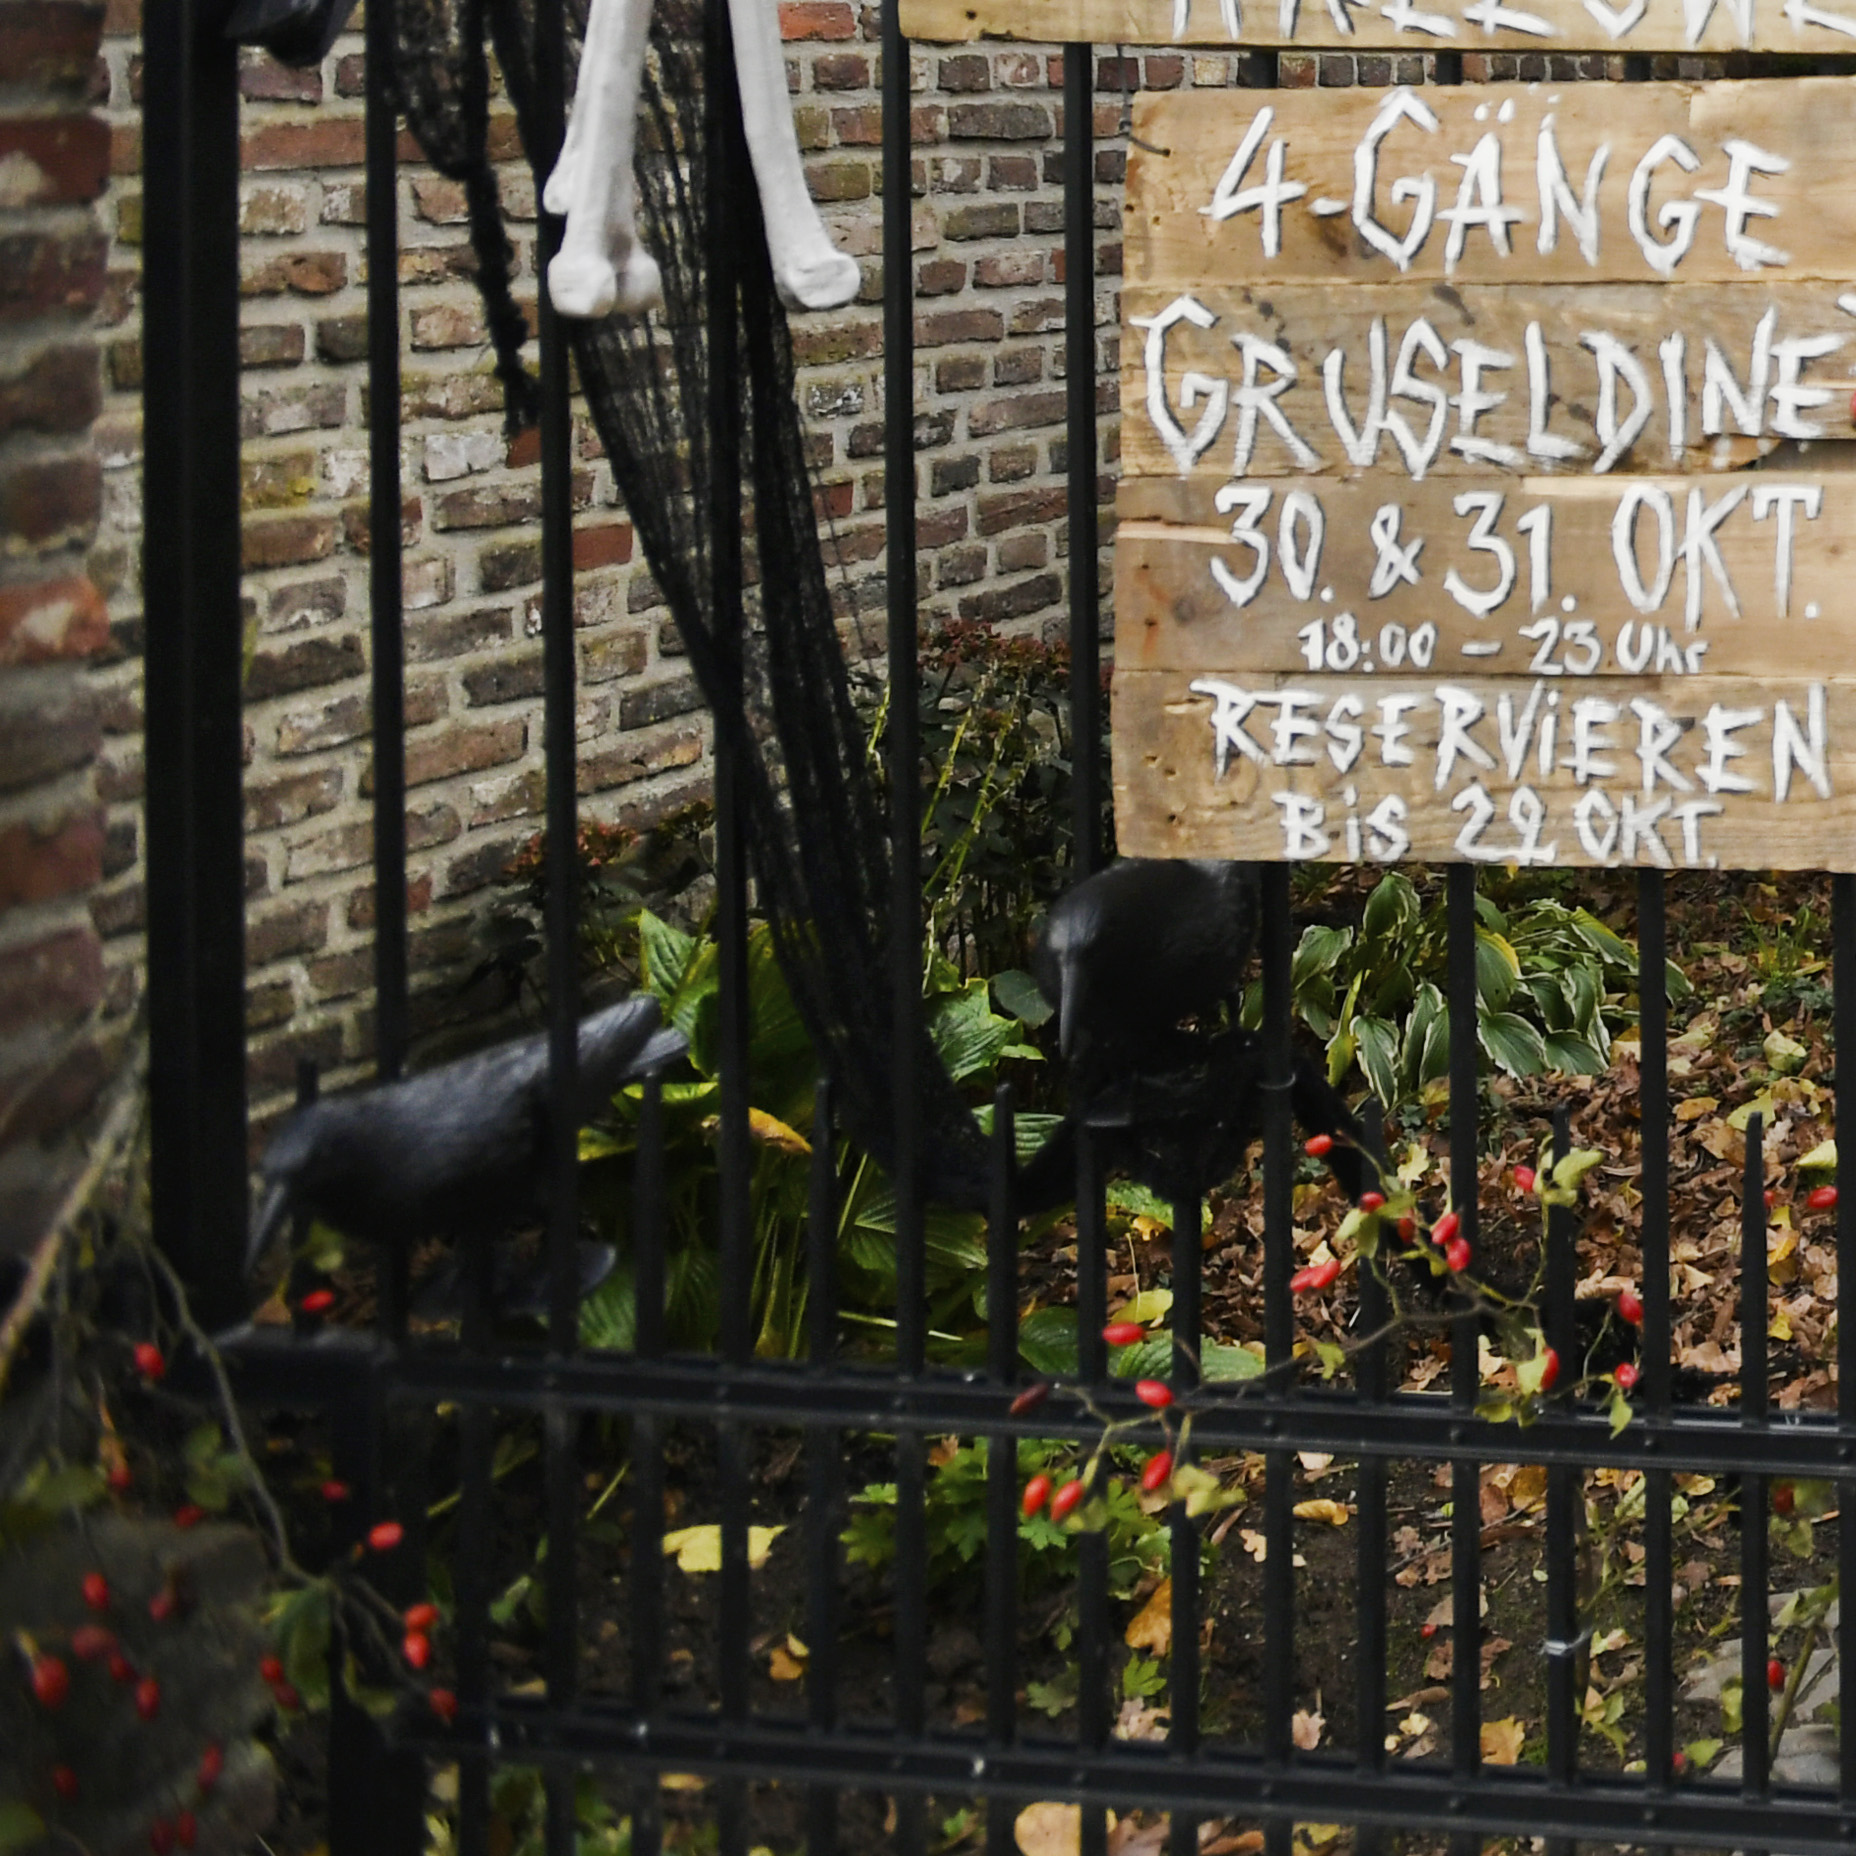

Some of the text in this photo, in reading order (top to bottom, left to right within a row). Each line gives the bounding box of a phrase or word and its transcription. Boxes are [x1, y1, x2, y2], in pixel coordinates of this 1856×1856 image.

[1210, 484, 1824, 632] 30. & 31. OKT.
[1298, 612, 1436, 671] 18:00
[1519, 616, 1600, 674] 23
[1616, 628, 1709, 675] Uhr
[1572, 788, 1724, 870] OKT.
